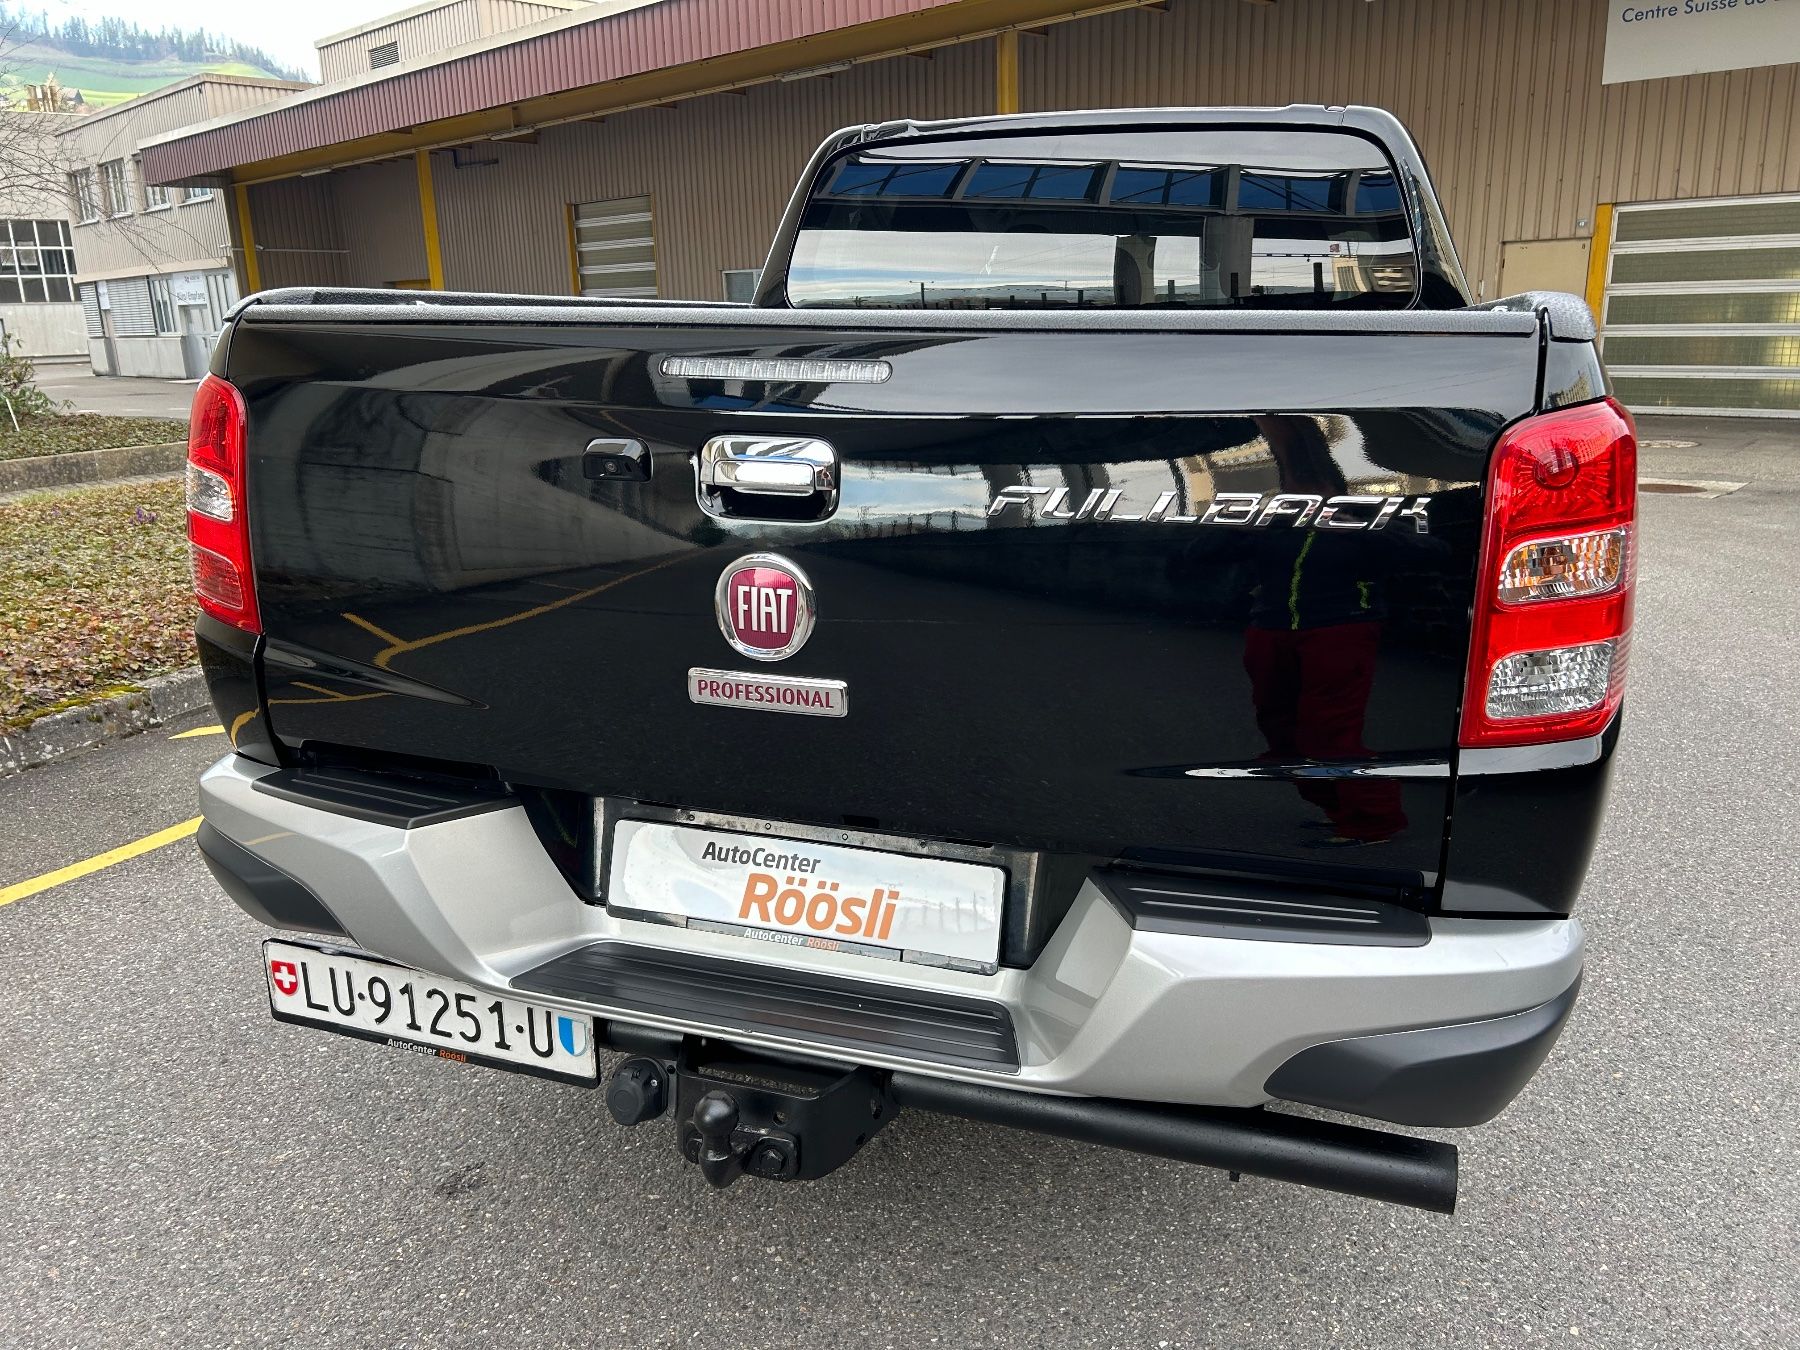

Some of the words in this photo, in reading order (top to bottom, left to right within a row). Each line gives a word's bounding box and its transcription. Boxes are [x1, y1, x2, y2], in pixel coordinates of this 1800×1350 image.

[1622, 5, 1678, 23] Centre
[1684, 0, 1738, 14] Suisse
[987, 485, 1432, 535] FULLBACK
[737, 585, 792, 634] FIAT
[697, 679, 834, 709] PROFESSIONAL
[701, 841, 821, 874] AutoCenter
[738, 872, 900, 940] Röösli
[743, 928, 804, 946] AutoCenter
[387, 1038, 437, 1056] AutoCenter
